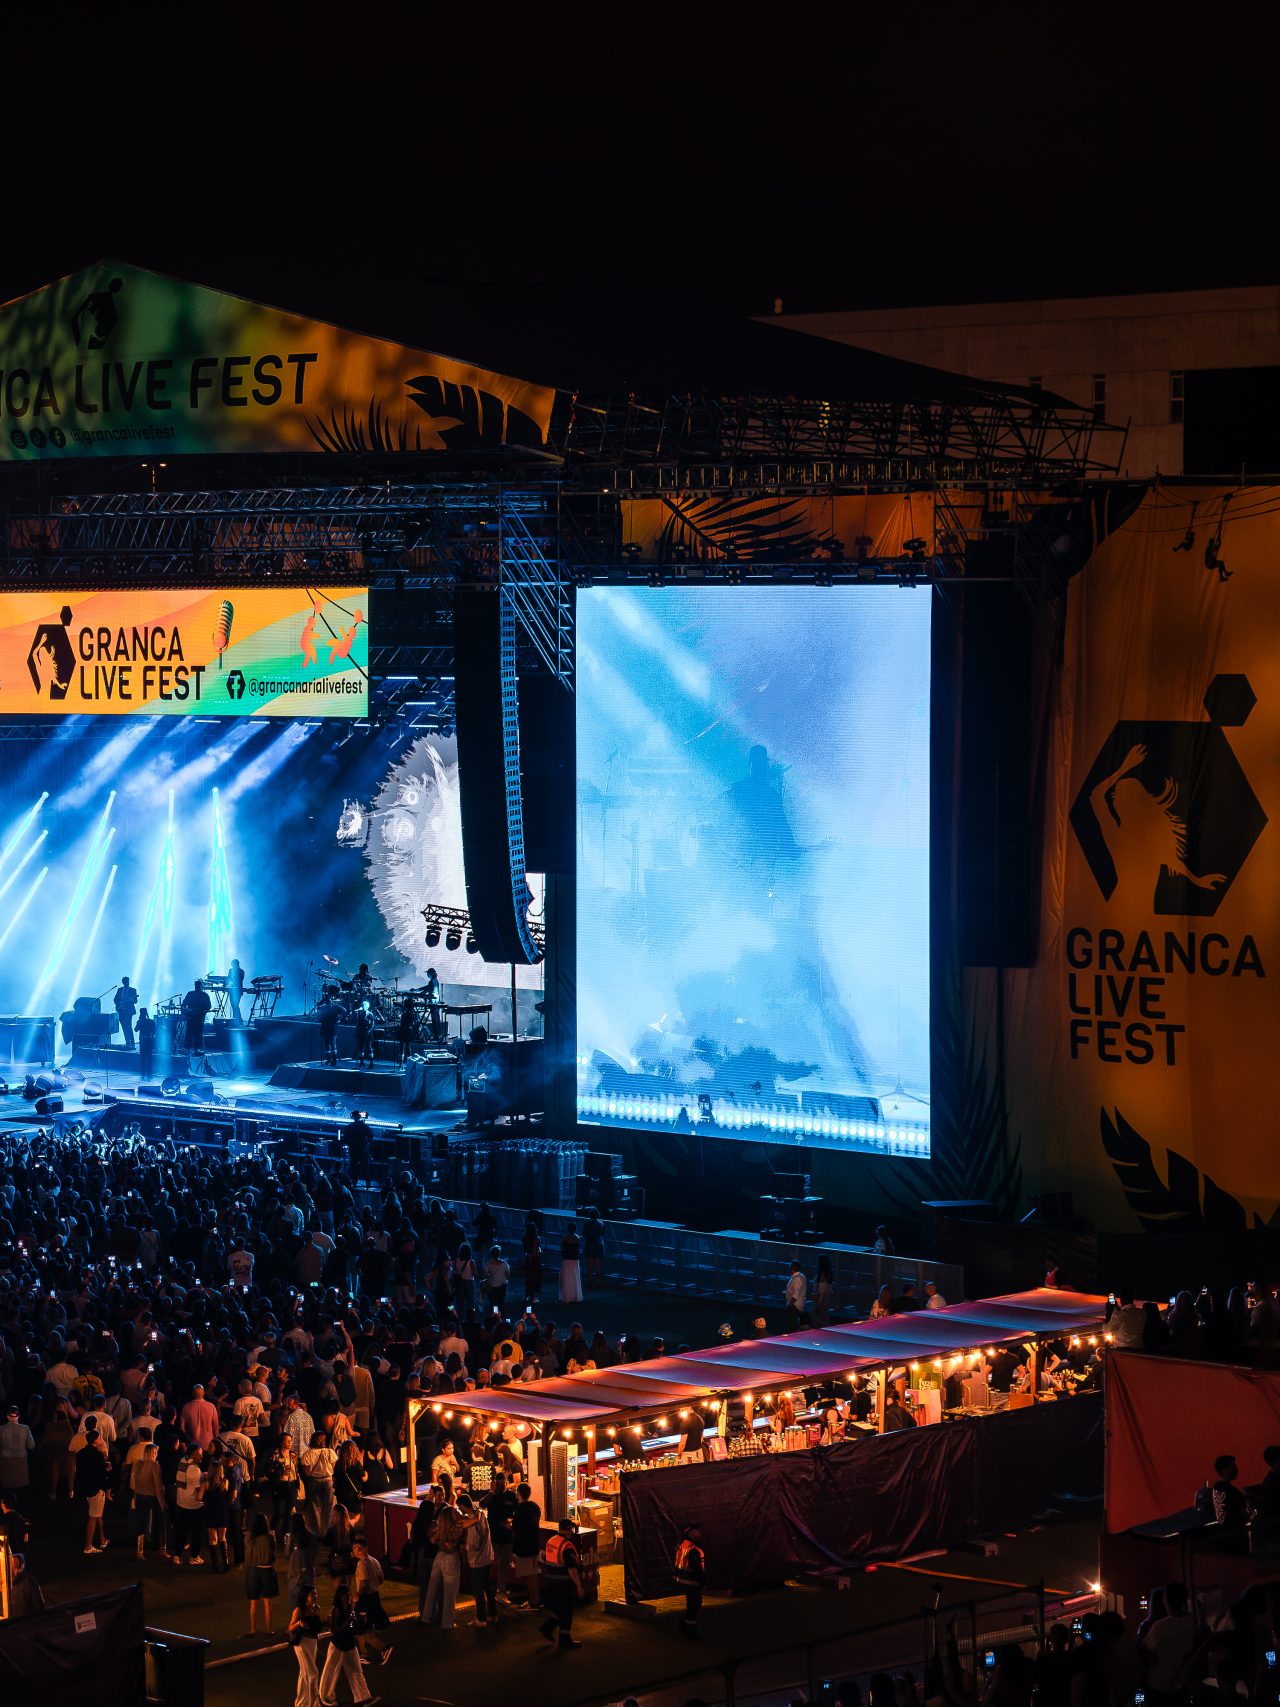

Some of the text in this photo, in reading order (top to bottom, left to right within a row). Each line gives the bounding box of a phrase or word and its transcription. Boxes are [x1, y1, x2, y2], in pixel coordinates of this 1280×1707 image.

[74, 359, 173, 415] LIVE
[190, 352, 319, 409] FEST
[70, 424, 177, 445] @grancalivefest
[78, 626, 185, 662] GRANCA
[79, 665, 206, 701] LIVE FEST
[248, 677, 363, 697] @grancanarialivefest
[1066, 926, 1266, 978] GRANCA
[1068, 972, 1166, 1020] LIVE
[1070, 1018, 1186, 1066] FEST
